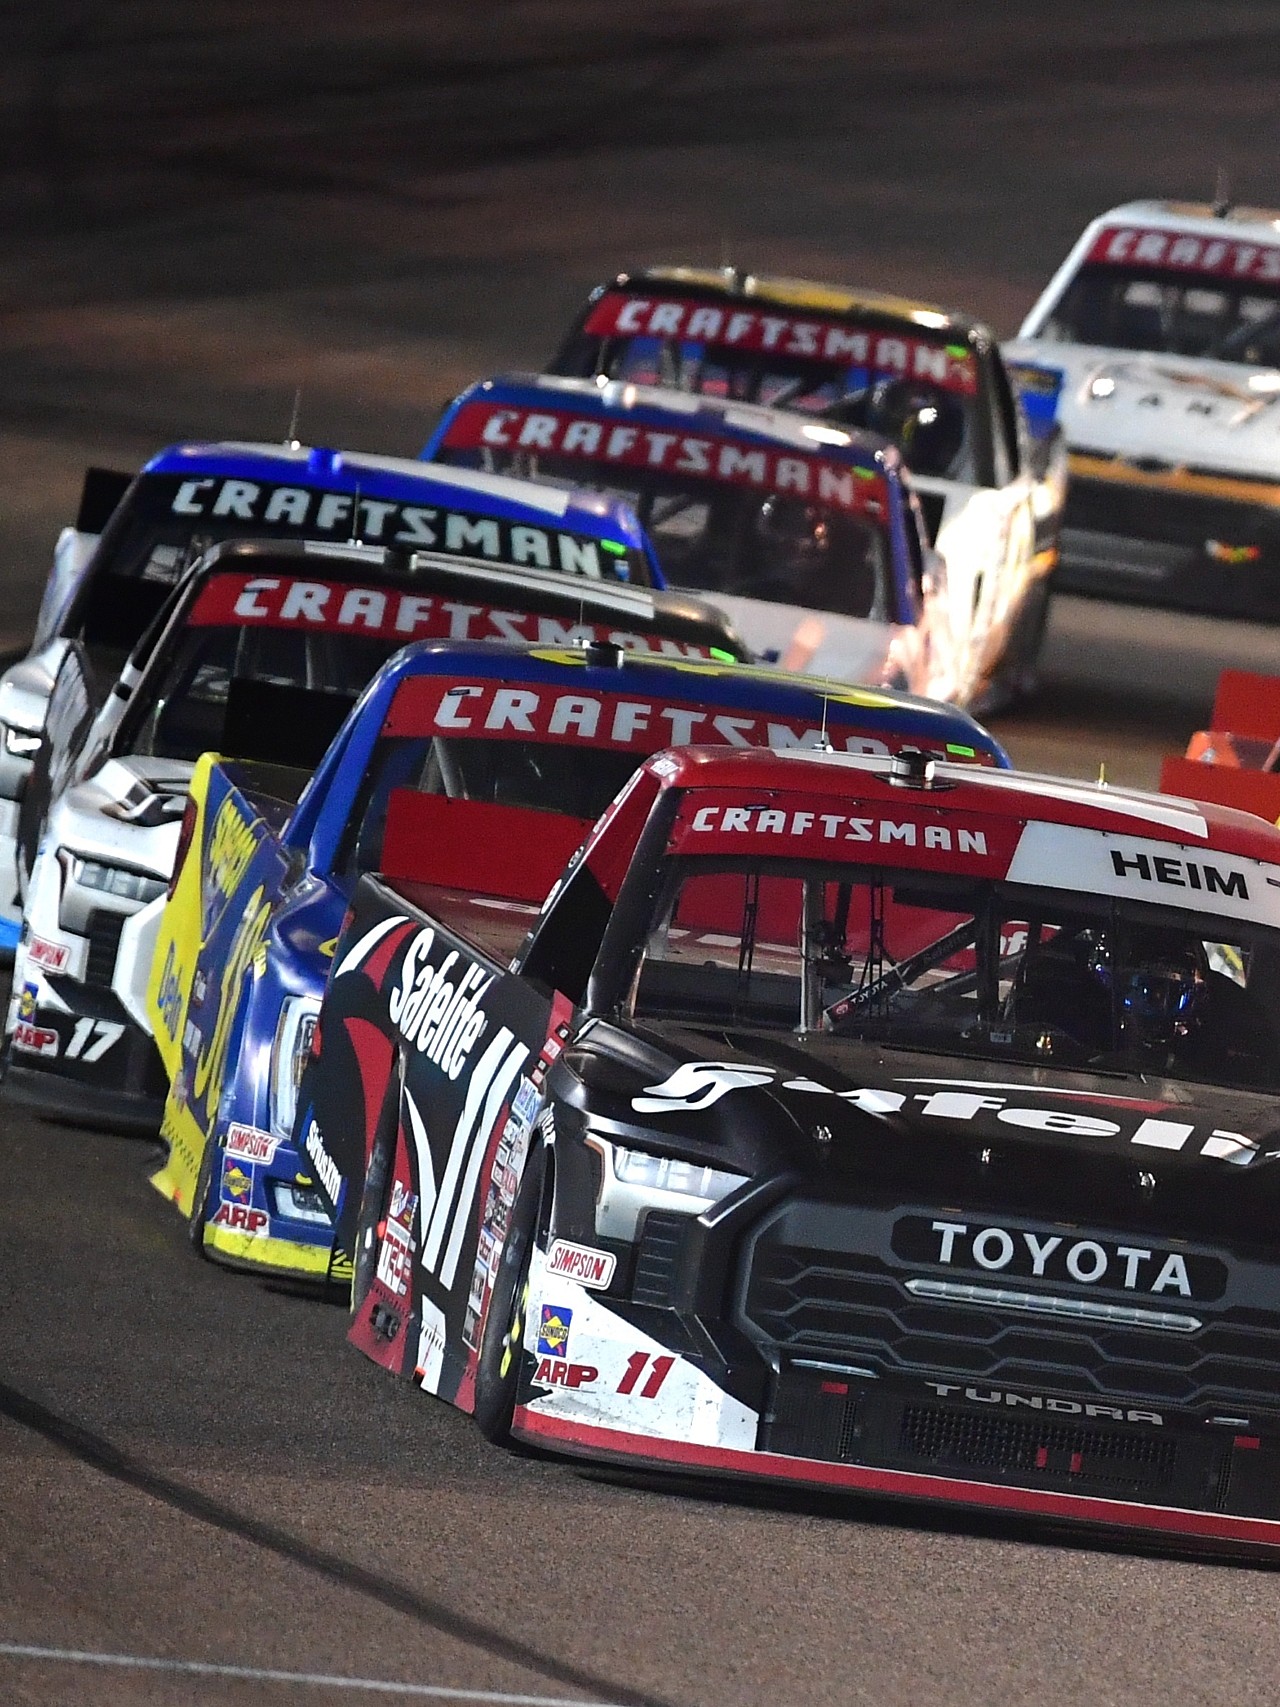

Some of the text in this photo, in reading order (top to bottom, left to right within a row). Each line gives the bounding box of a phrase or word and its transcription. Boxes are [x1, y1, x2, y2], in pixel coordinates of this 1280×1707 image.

[616, 300, 947, 379] CRAFTSMAN
[483, 410, 855, 506] CRAFTSMAN
[172, 479, 600, 579] CRAFTSMAN
[433, 686, 946, 759] CRAFTSM
[690, 807, 1251, 901] CRAFTSMAN HEIM
[389, 927, 496, 1081] Safelite
[64, 1016, 126, 1063] 17
[213, 1203, 268, 1232] ARP
[550, 1246, 607, 1282] SIMPSON
[931, 1220, 1192, 1297] TOYOTA
[541, 1323, 568, 1342] SUNOCO
[534, 1358, 599, 1388] ARP
[615, 1350, 676, 1399] 11
[924, 1380, 1164, 1426] TUNDRA
